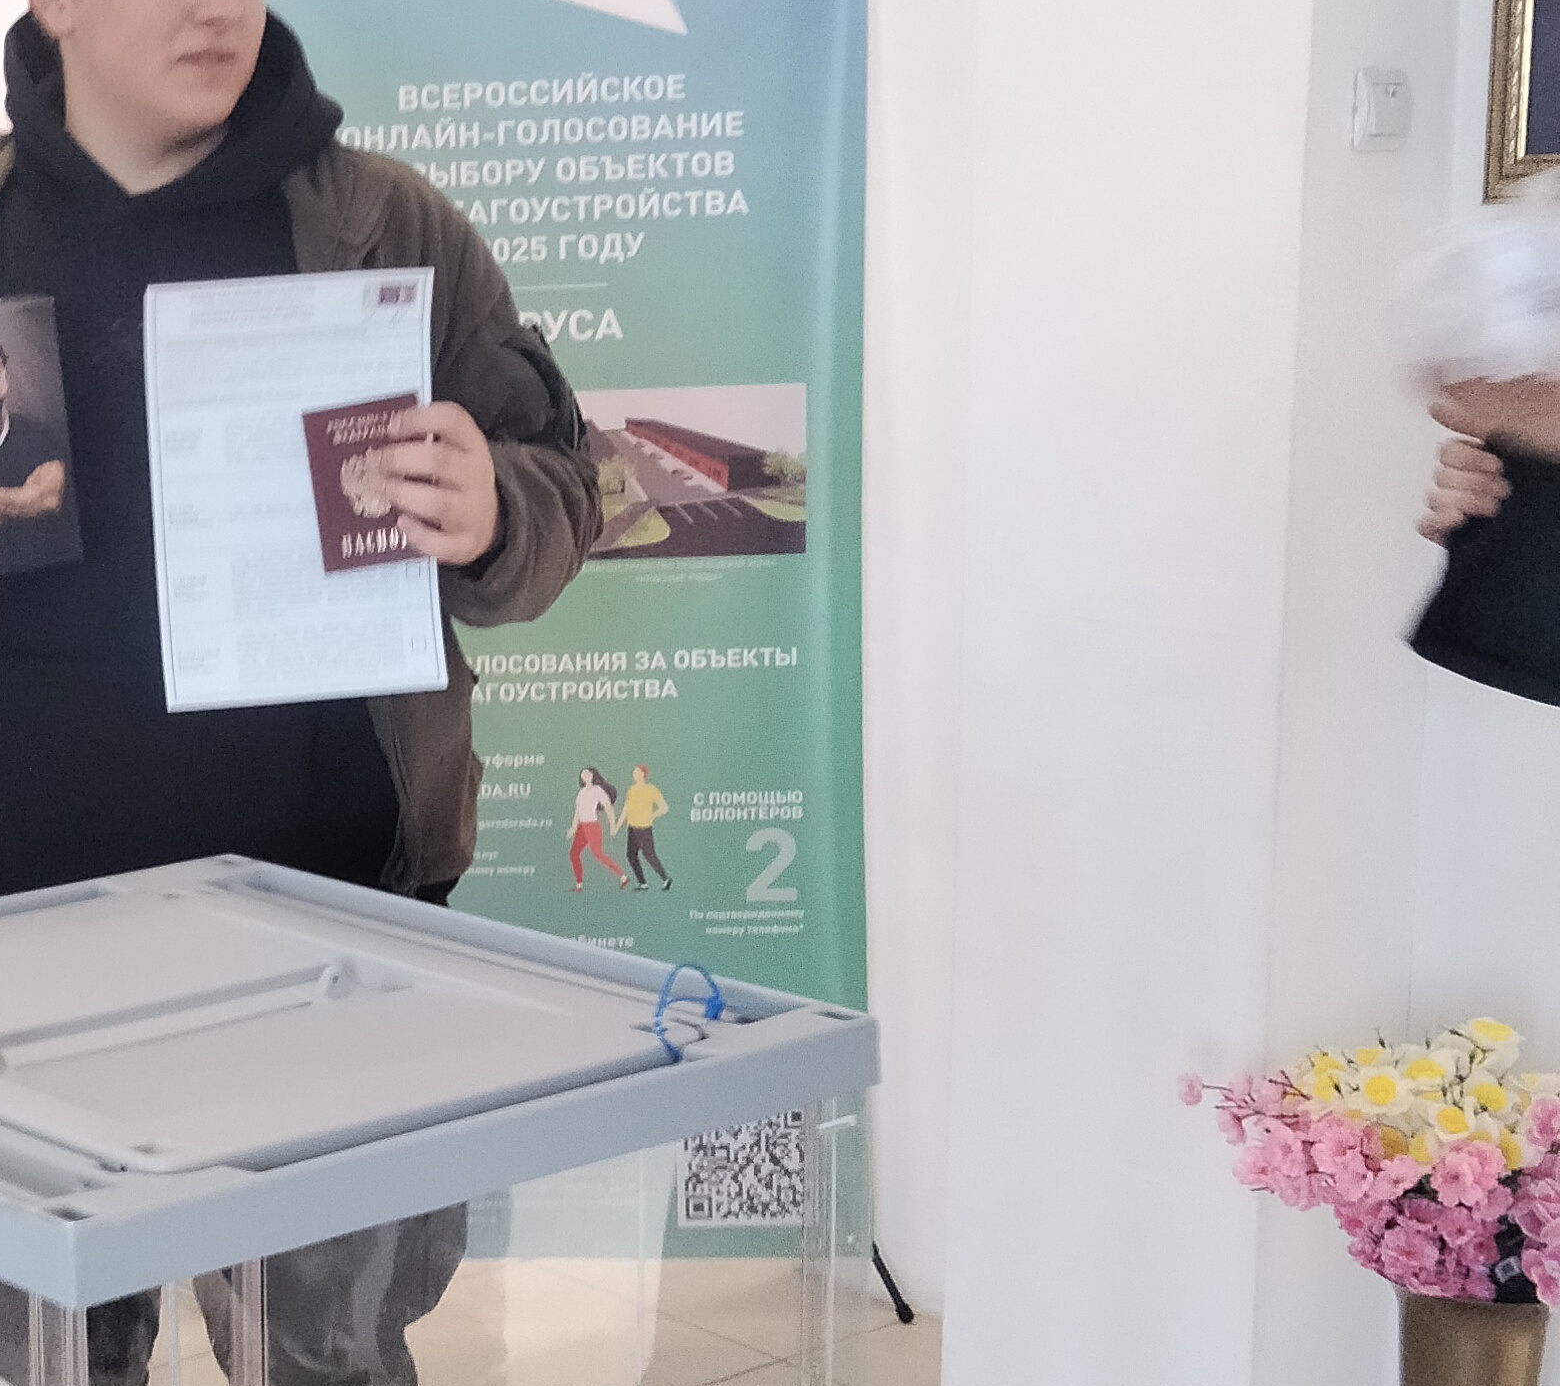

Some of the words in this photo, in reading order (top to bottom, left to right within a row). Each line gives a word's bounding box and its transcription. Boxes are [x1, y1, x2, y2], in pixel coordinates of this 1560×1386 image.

[397, 72, 687, 114] ВСЕРОССИЙСКОЕ
[555, 149, 736, 184] ОБЪЕКТОВ
[489, 234, 548, 265] 025
[558, 229, 646, 266] ГОДУ
[471, 650, 628, 677] ЛОСОВАНИЯ
[634, 648, 667, 672] ЗА
[673, 645, 798, 672] ОБЪЕКТЫ
[471, 676, 679, 704] АГОУСТРОЙСТВА
[690, 805, 804, 824] ВОЛОНТЕРОВ
[708, 789, 804, 807] ПОМОЩЬЮ
[745, 827, 798, 903] 2
